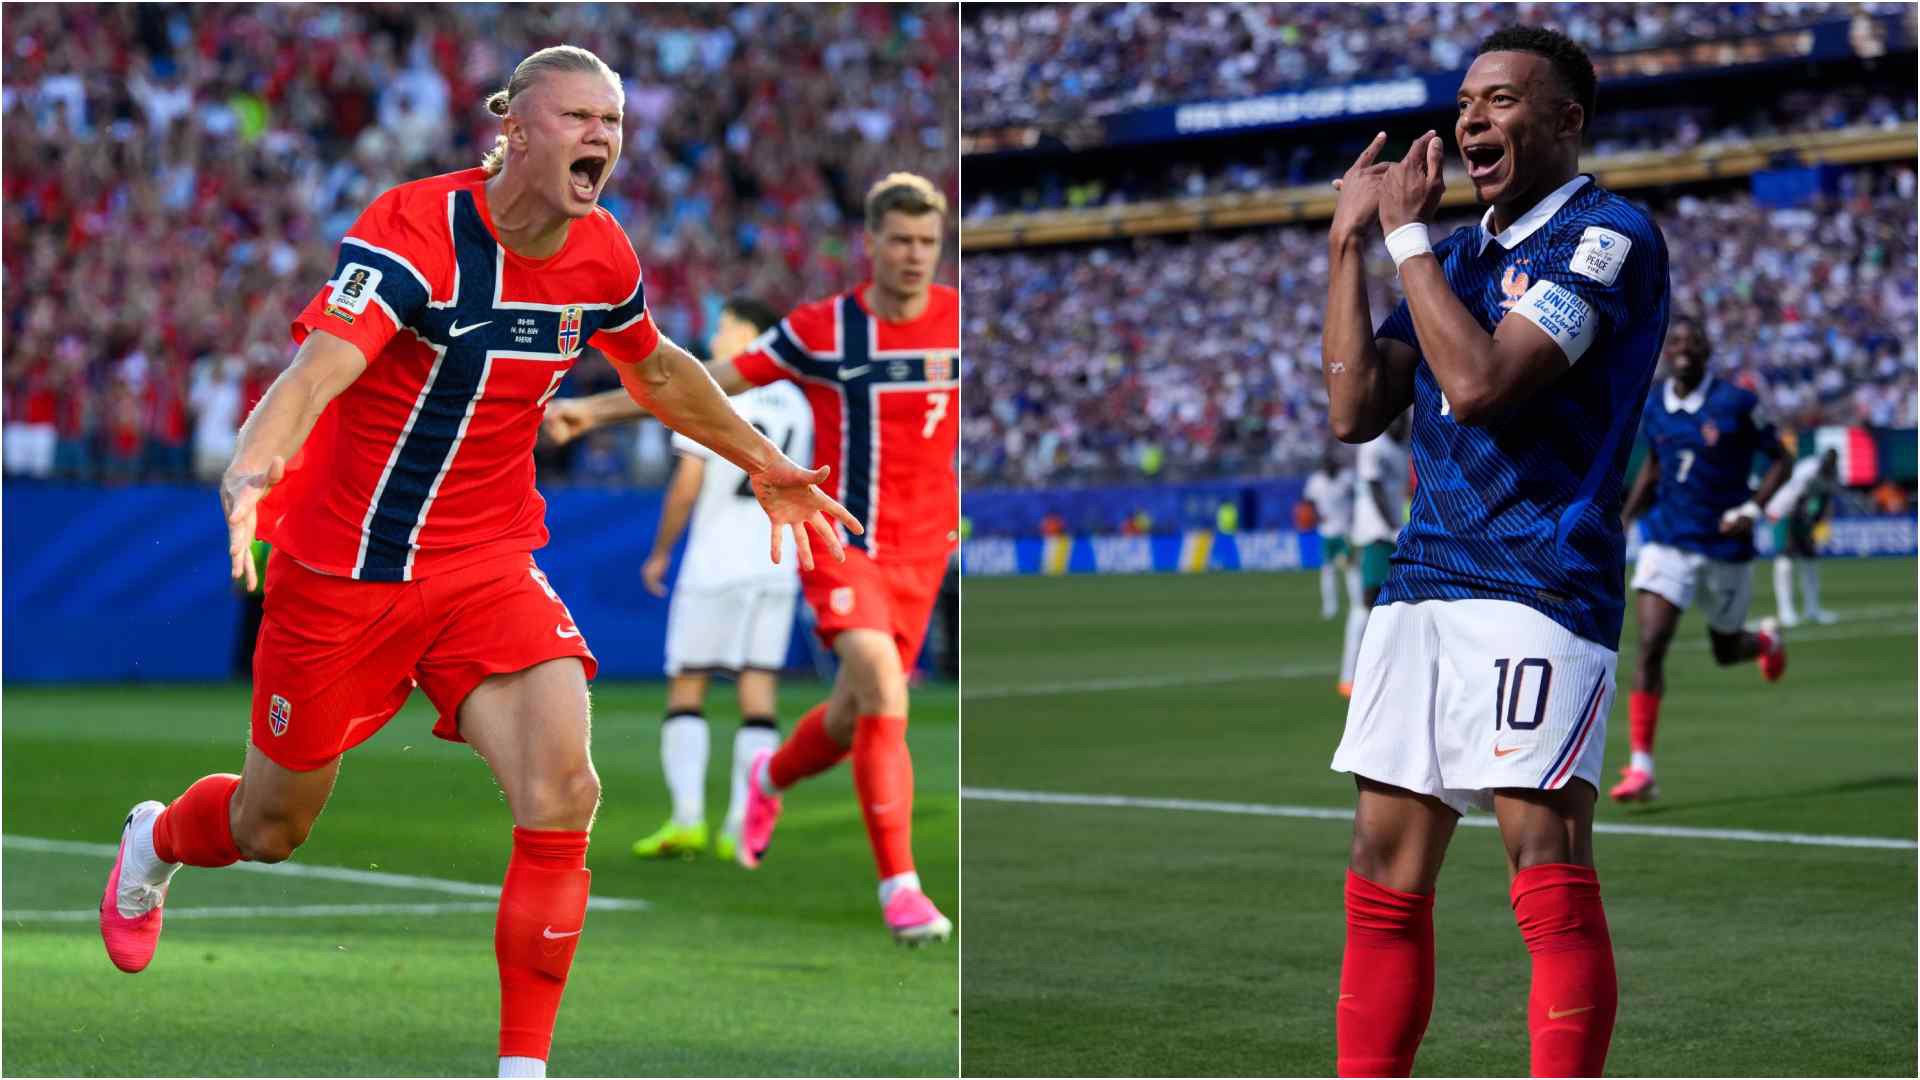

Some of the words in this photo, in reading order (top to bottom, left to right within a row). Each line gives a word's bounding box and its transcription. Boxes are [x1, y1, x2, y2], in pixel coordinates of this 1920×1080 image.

[1534, 299, 1551, 314] the
[1543, 289, 1585, 328] UNITES
[1552, 283, 1590, 319] FOOTBALL
[922, 391, 951, 440] 7
[1676, 449, 1696, 484] 7
[1494, 657, 1552, 731] 10
